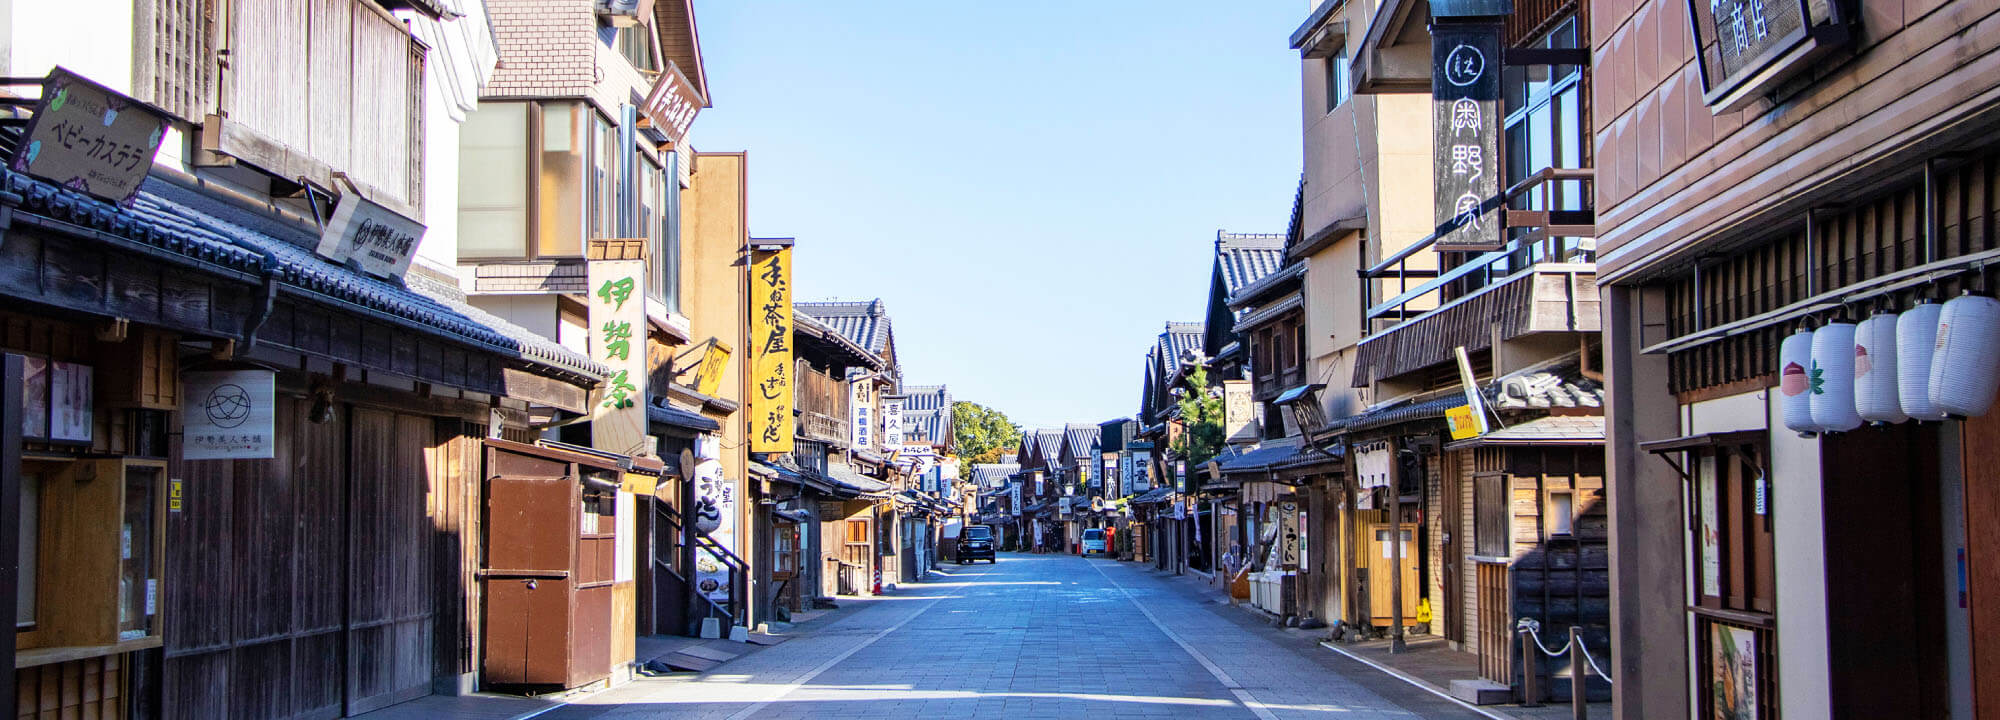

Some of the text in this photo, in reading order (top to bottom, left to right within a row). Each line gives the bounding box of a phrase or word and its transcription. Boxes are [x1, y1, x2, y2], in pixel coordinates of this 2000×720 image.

[52, 120, 143, 171] ベビーカステラ
[597, 276, 636, 409] 伊勢茶
[888, 404, 900, 445] 喜久屋
